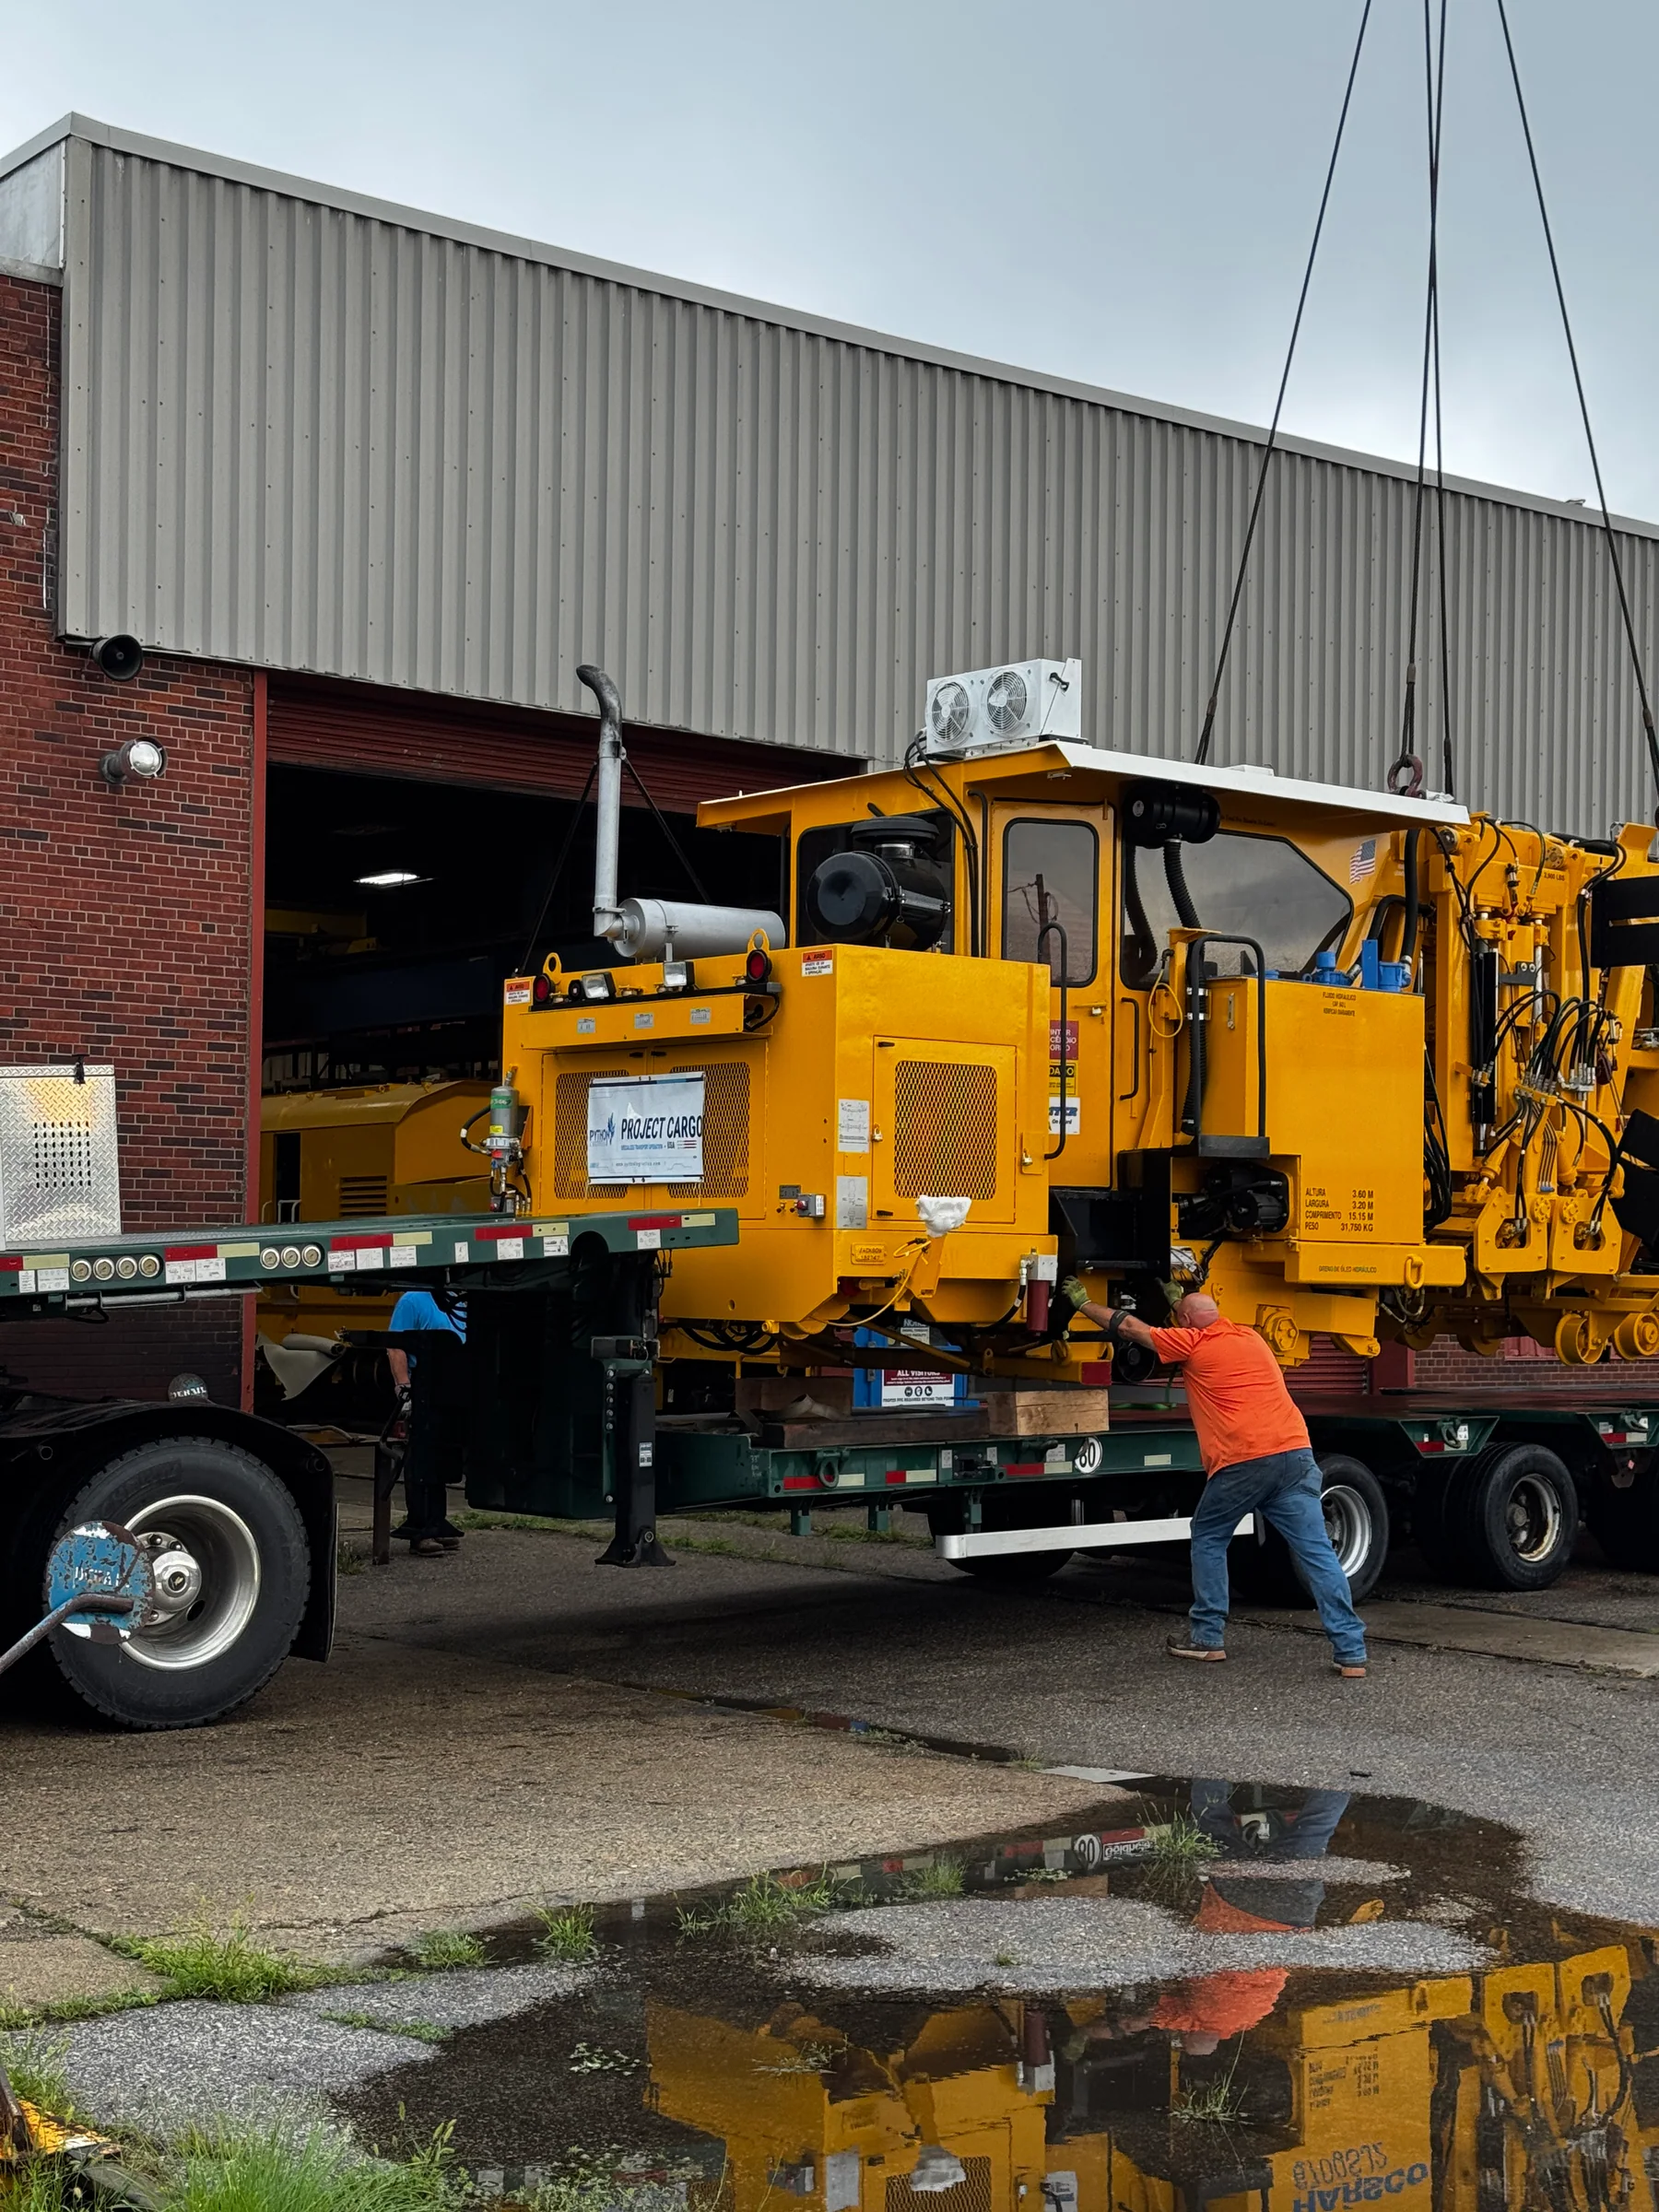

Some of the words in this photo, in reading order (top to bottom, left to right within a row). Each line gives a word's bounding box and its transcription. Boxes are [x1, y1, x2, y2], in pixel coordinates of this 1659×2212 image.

[1049, 1066, 1075, 1076] DAO
[621, 1117, 665, 1140] PROJECT
[666, 1115, 702, 1139] CARGO
[667, 1141, 676, 1149] USA
[1305, 1187, 1326, 1197] ALTURA
[1351, 1189, 1366, 1199] 3.60
[1367, 1190, 1374, 1199] M
[1305, 1199, 1329, 1208] LARGURA
[1351, 1201, 1366, 1209] 3.20
[1367, 1201, 1374, 1210] M
[1305, 1210, 1342, 1220] COMPRIMENTO
[1348, 1212, 1366, 1221] 15.15
[1367, 1212, 1374, 1221] M
[1305, 1221, 1319, 1230] PESO
[1363, 1223, 1373, 1232] KG
[903, 1318, 926, 1327] NOTI
